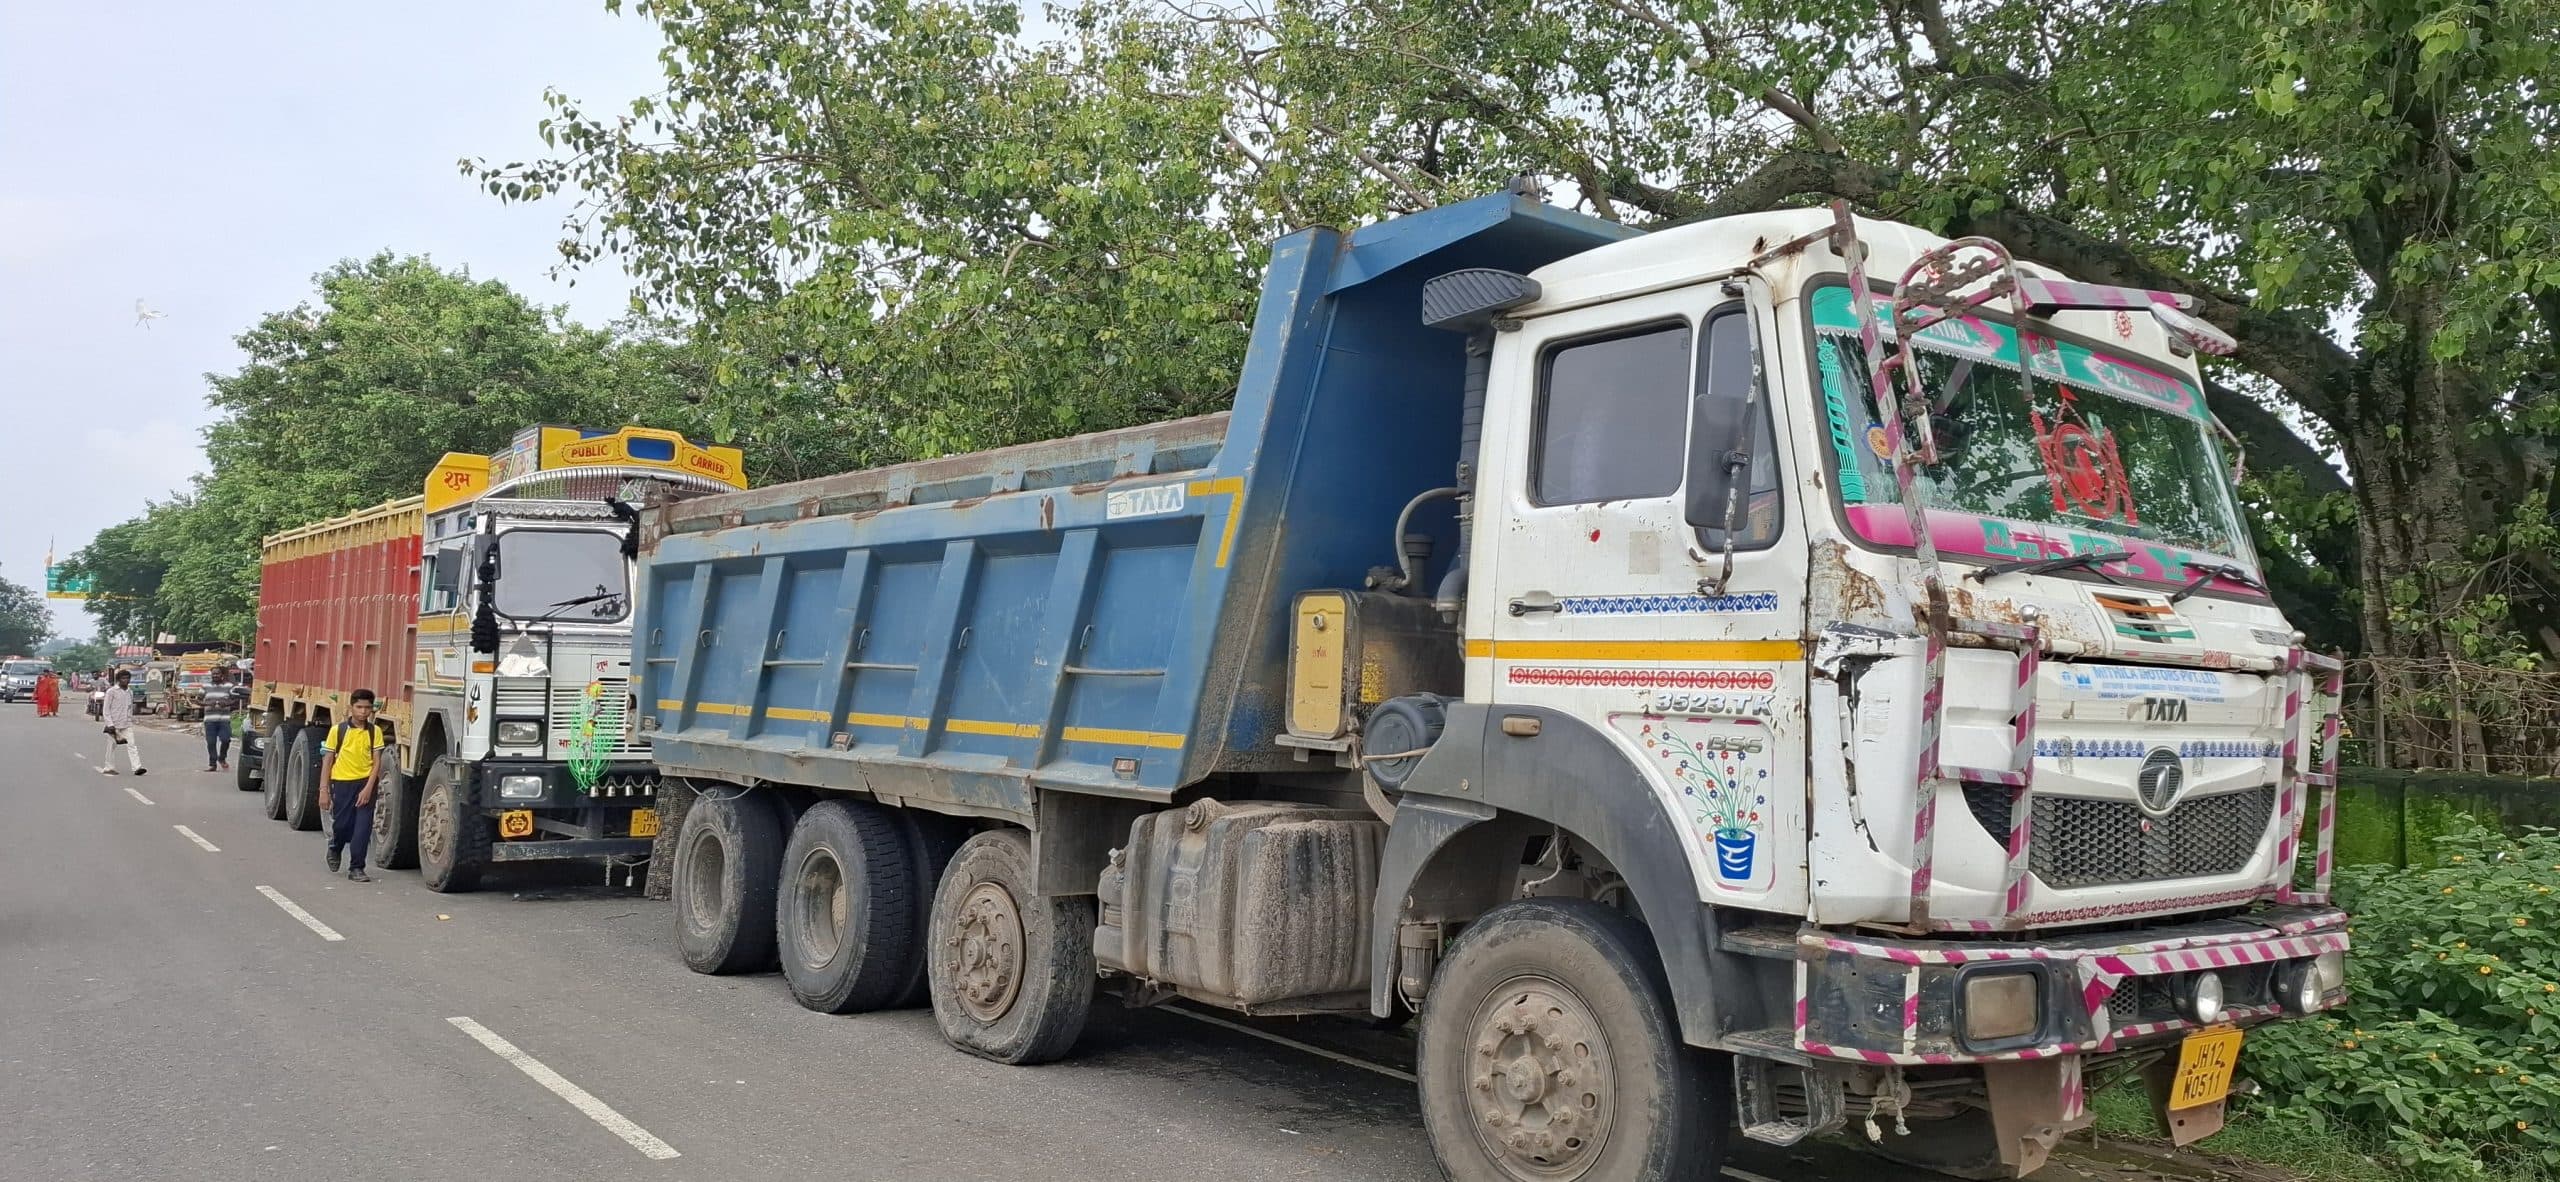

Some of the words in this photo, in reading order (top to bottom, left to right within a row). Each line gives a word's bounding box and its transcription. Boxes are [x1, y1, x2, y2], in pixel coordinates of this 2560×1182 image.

[571, 445, 608, 458] PUBLIC
[690, 454, 725, 474] CARRIER
[444, 471, 471, 491] शुभ
[1128, 487, 1183, 515] TATA
[1655, 692, 1776, 716] 3523.TK
[2144, 697, 2187, 722] TATA
[1706, 734, 1764, 754] BS6
[2192, 1041, 2225, 1069] JH12
